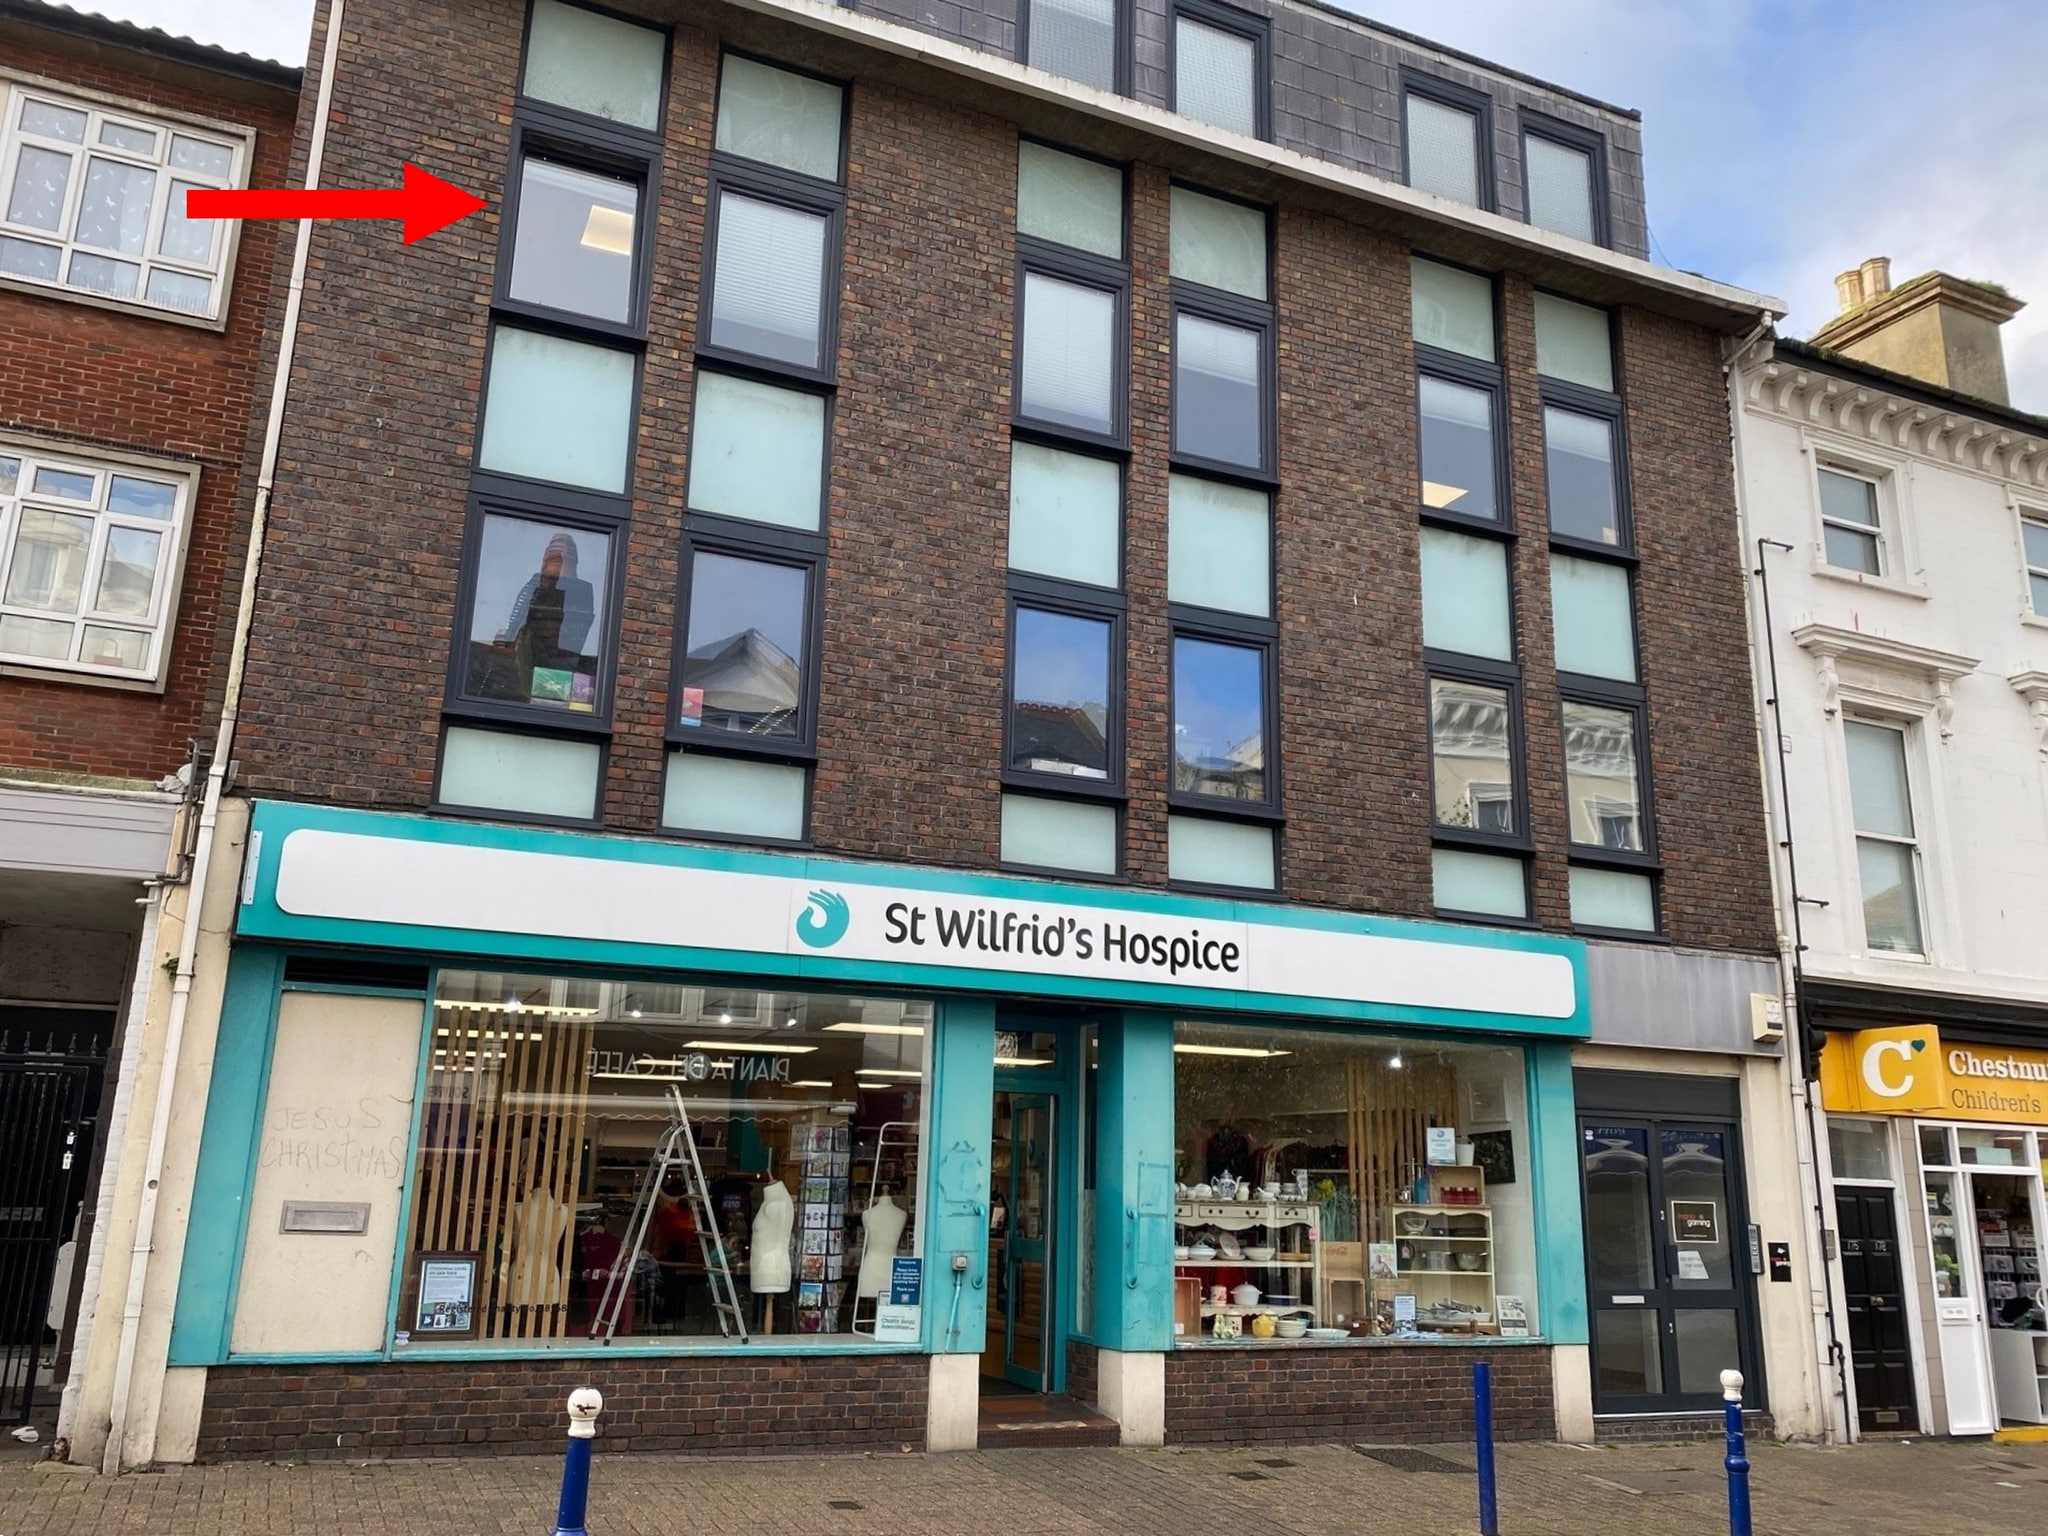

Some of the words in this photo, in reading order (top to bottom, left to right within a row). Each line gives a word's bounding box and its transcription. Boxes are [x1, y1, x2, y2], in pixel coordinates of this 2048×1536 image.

[885, 902, 926, 945] St
[935, 907, 1093, 960] Wilfrid's
[1103, 922, 1240, 976] Hospice
[1862, 1039, 1914, 1098] C
[1949, 1049, 2048, 1081] Chestnu
[272, 1097, 381, 1131] JESUS
[1951, 1088, 2042, 1114] Children's
[1687, 1219, 1711, 1228] gaming
